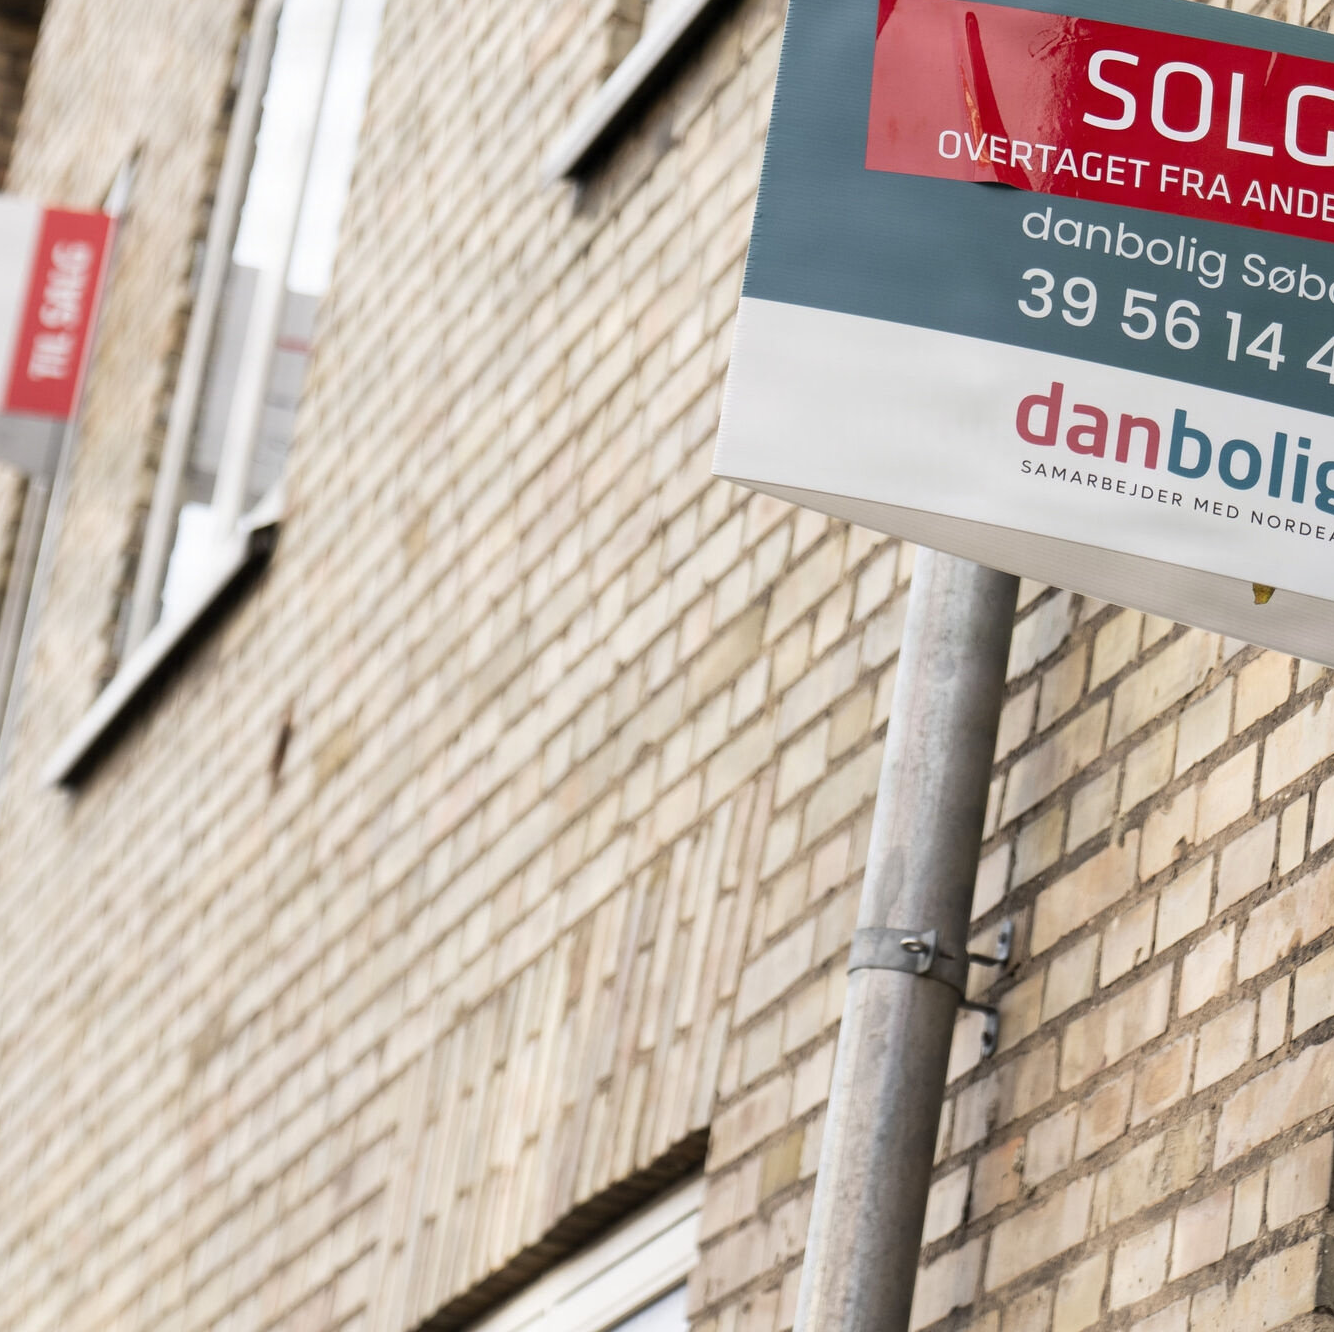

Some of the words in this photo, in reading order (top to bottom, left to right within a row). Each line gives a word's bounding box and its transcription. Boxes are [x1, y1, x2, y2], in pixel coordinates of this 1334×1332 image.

[938, 129, 1150, 189] OVERTAGET
[1159, 164, 1232, 205] FRA
[1022, 206, 1227, 290] danbolig
[1017, 267, 1098, 328] 39
[1120, 287, 1202, 351] 56
[1225, 310, 1286, 372] 14
[1020, 459, 1183, 508] SAMARBEJDER
[1194, 497, 1240, 520] MED
